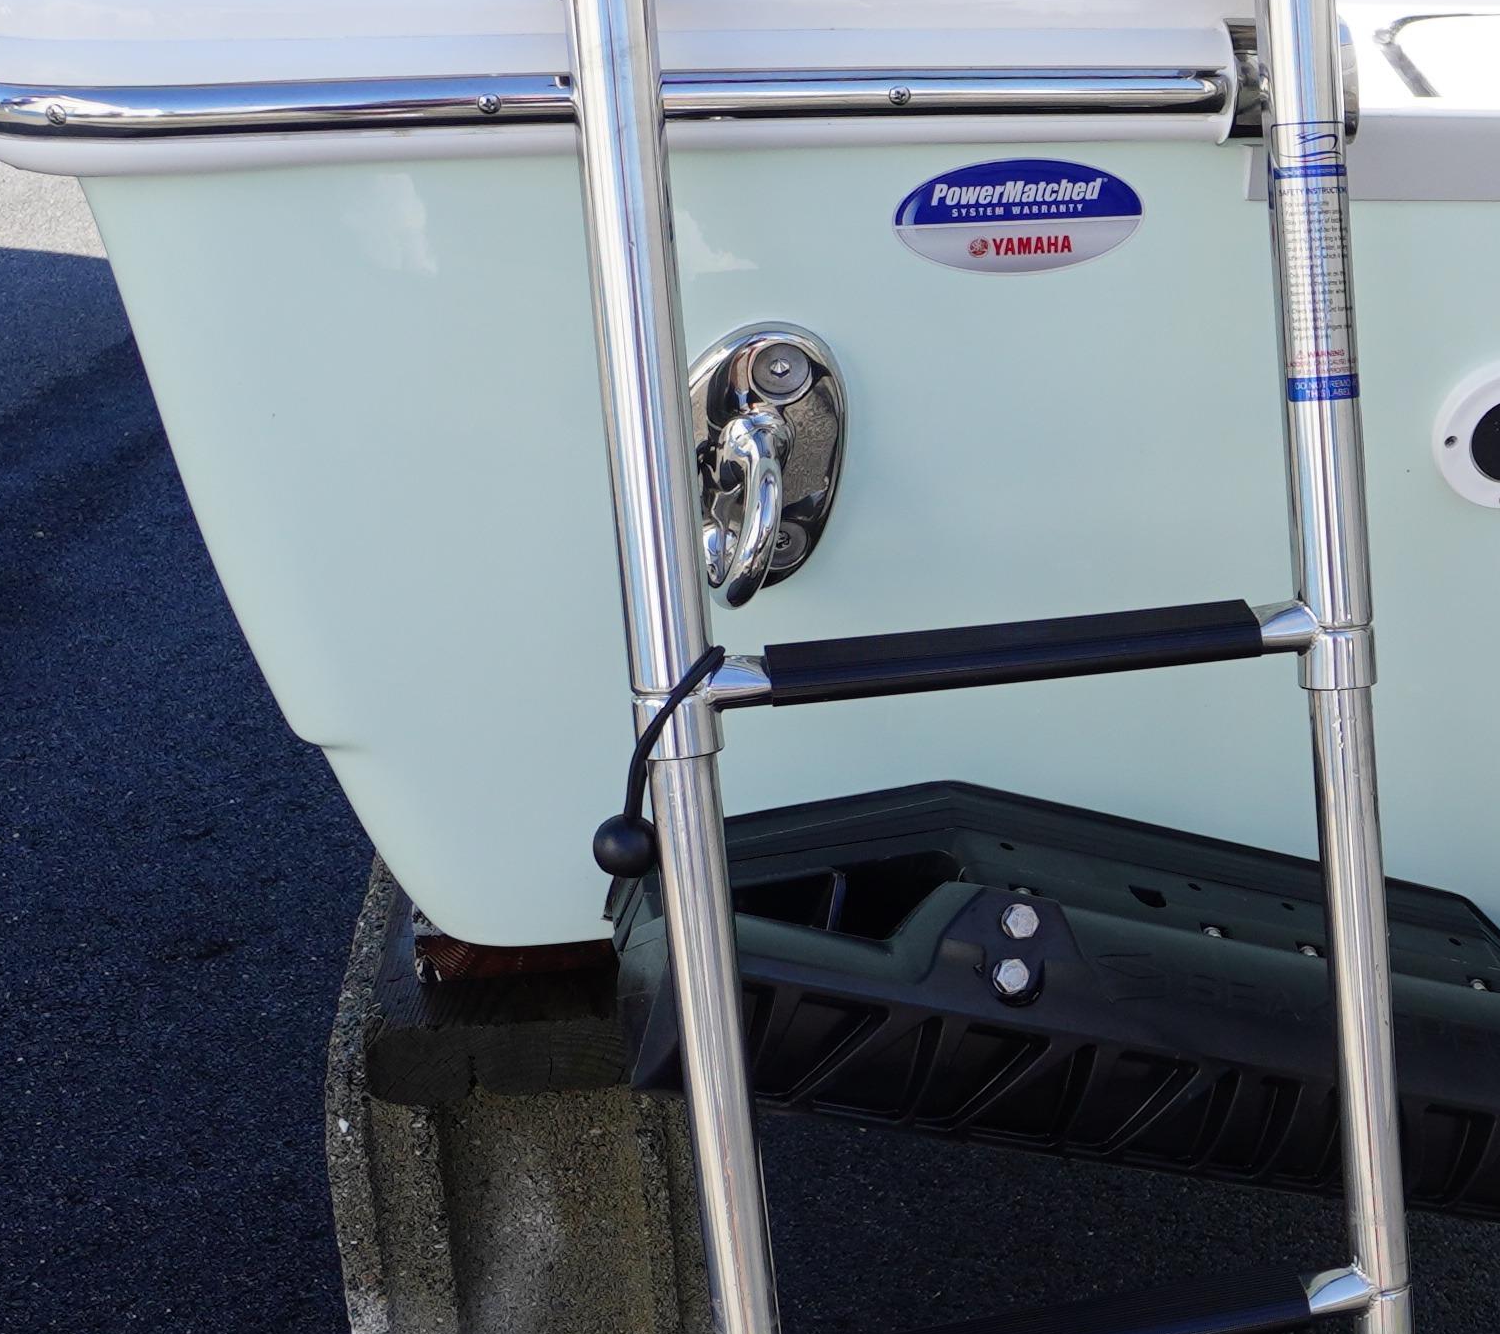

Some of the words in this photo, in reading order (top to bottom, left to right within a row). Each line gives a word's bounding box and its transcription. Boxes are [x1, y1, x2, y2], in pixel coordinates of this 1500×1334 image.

[951, 206, 1005, 218] SYSTEM
[1011, 203, 1085, 216] WARRANTY
[992, 234, 1073, 257] YAMAHA
